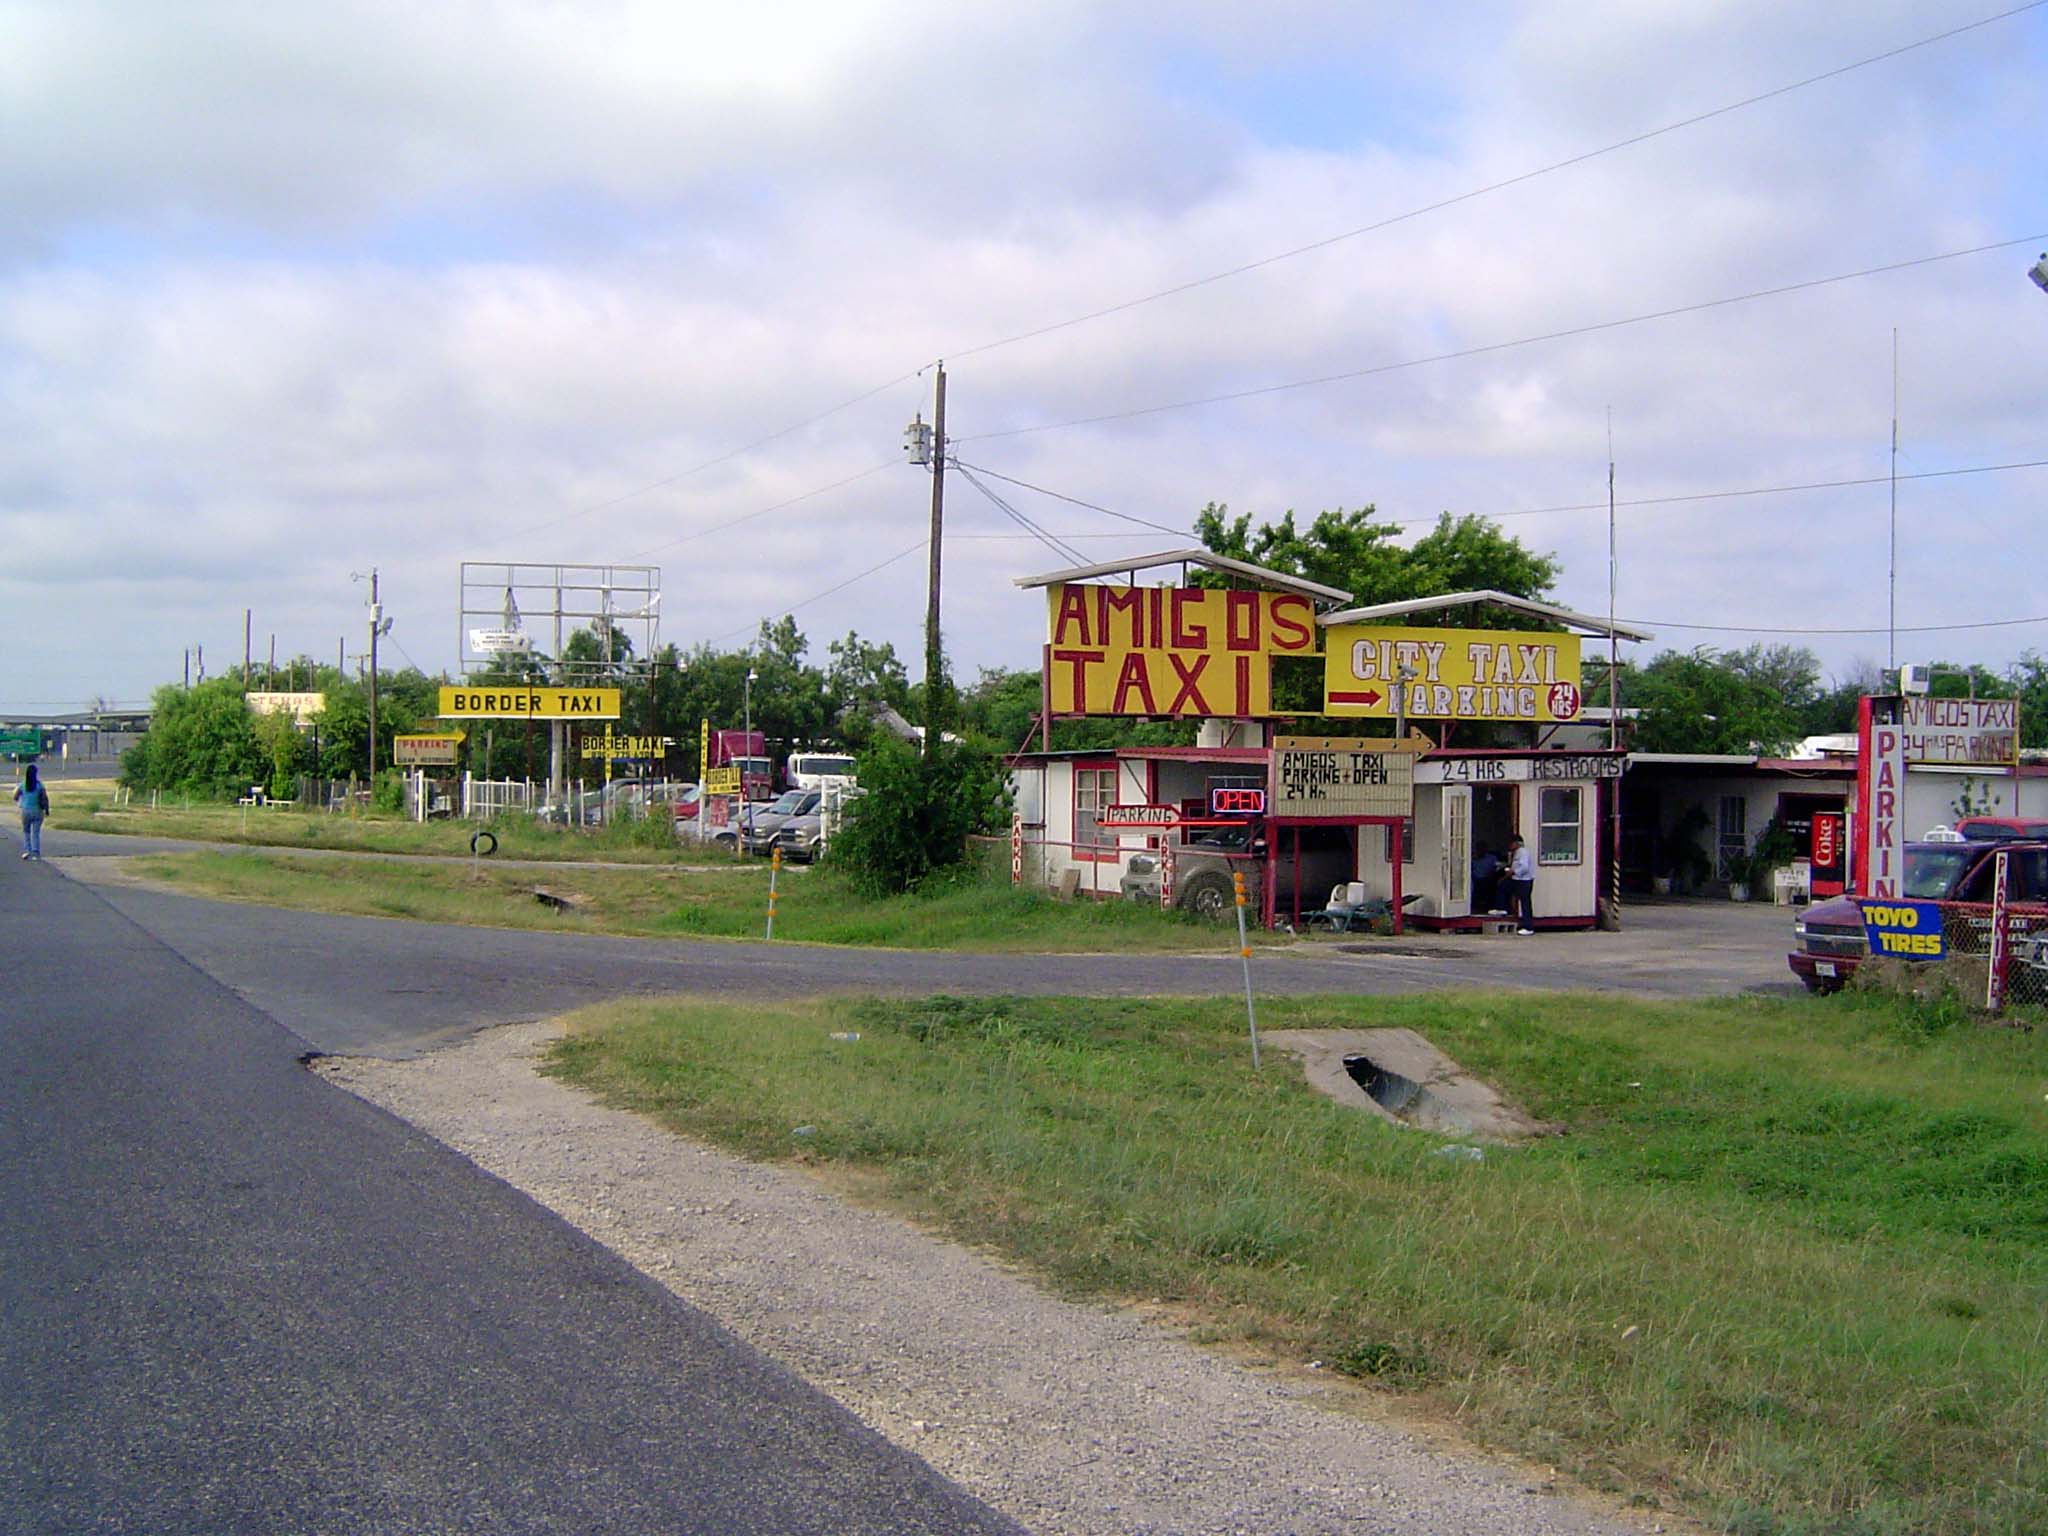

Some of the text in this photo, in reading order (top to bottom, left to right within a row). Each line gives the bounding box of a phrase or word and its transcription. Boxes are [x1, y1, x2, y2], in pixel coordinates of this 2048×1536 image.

[1054, 583, 1311, 652] AMIGOS
[1350, 639, 1558, 685] CITY TAXI
[1053, 650, 1250, 716] TAXI
[1553, 684, 1574, 700] 24
[454, 694, 602, 712] BORDER TAXI
[1387, 683, 1537, 717] PARKING
[1902, 701, 2016, 728] AMIGOS TAXI
[1282, 752, 1384, 769] AMIGOS TAXI
[1944, 734, 2013, 762] PARKING
[1282, 768, 1341, 785] PARKING
[1353, 769, 1388, 785] OPEN
[1441, 757, 1620, 781] 24 HRS RESTROOMS
[1215, 791, 1261, 810] OPEN
[1287, 784, 1305, 800] 24
[1111, 807, 1172, 823] PARKING
[1873, 731, 1896, 898] PARKIN
[1012, 814, 1021, 885] PARKIN
[1816, 818, 1833, 866] Coke
[1546, 851, 1577, 862] OPEN
[1878, 931, 1942, 956] TIRES
